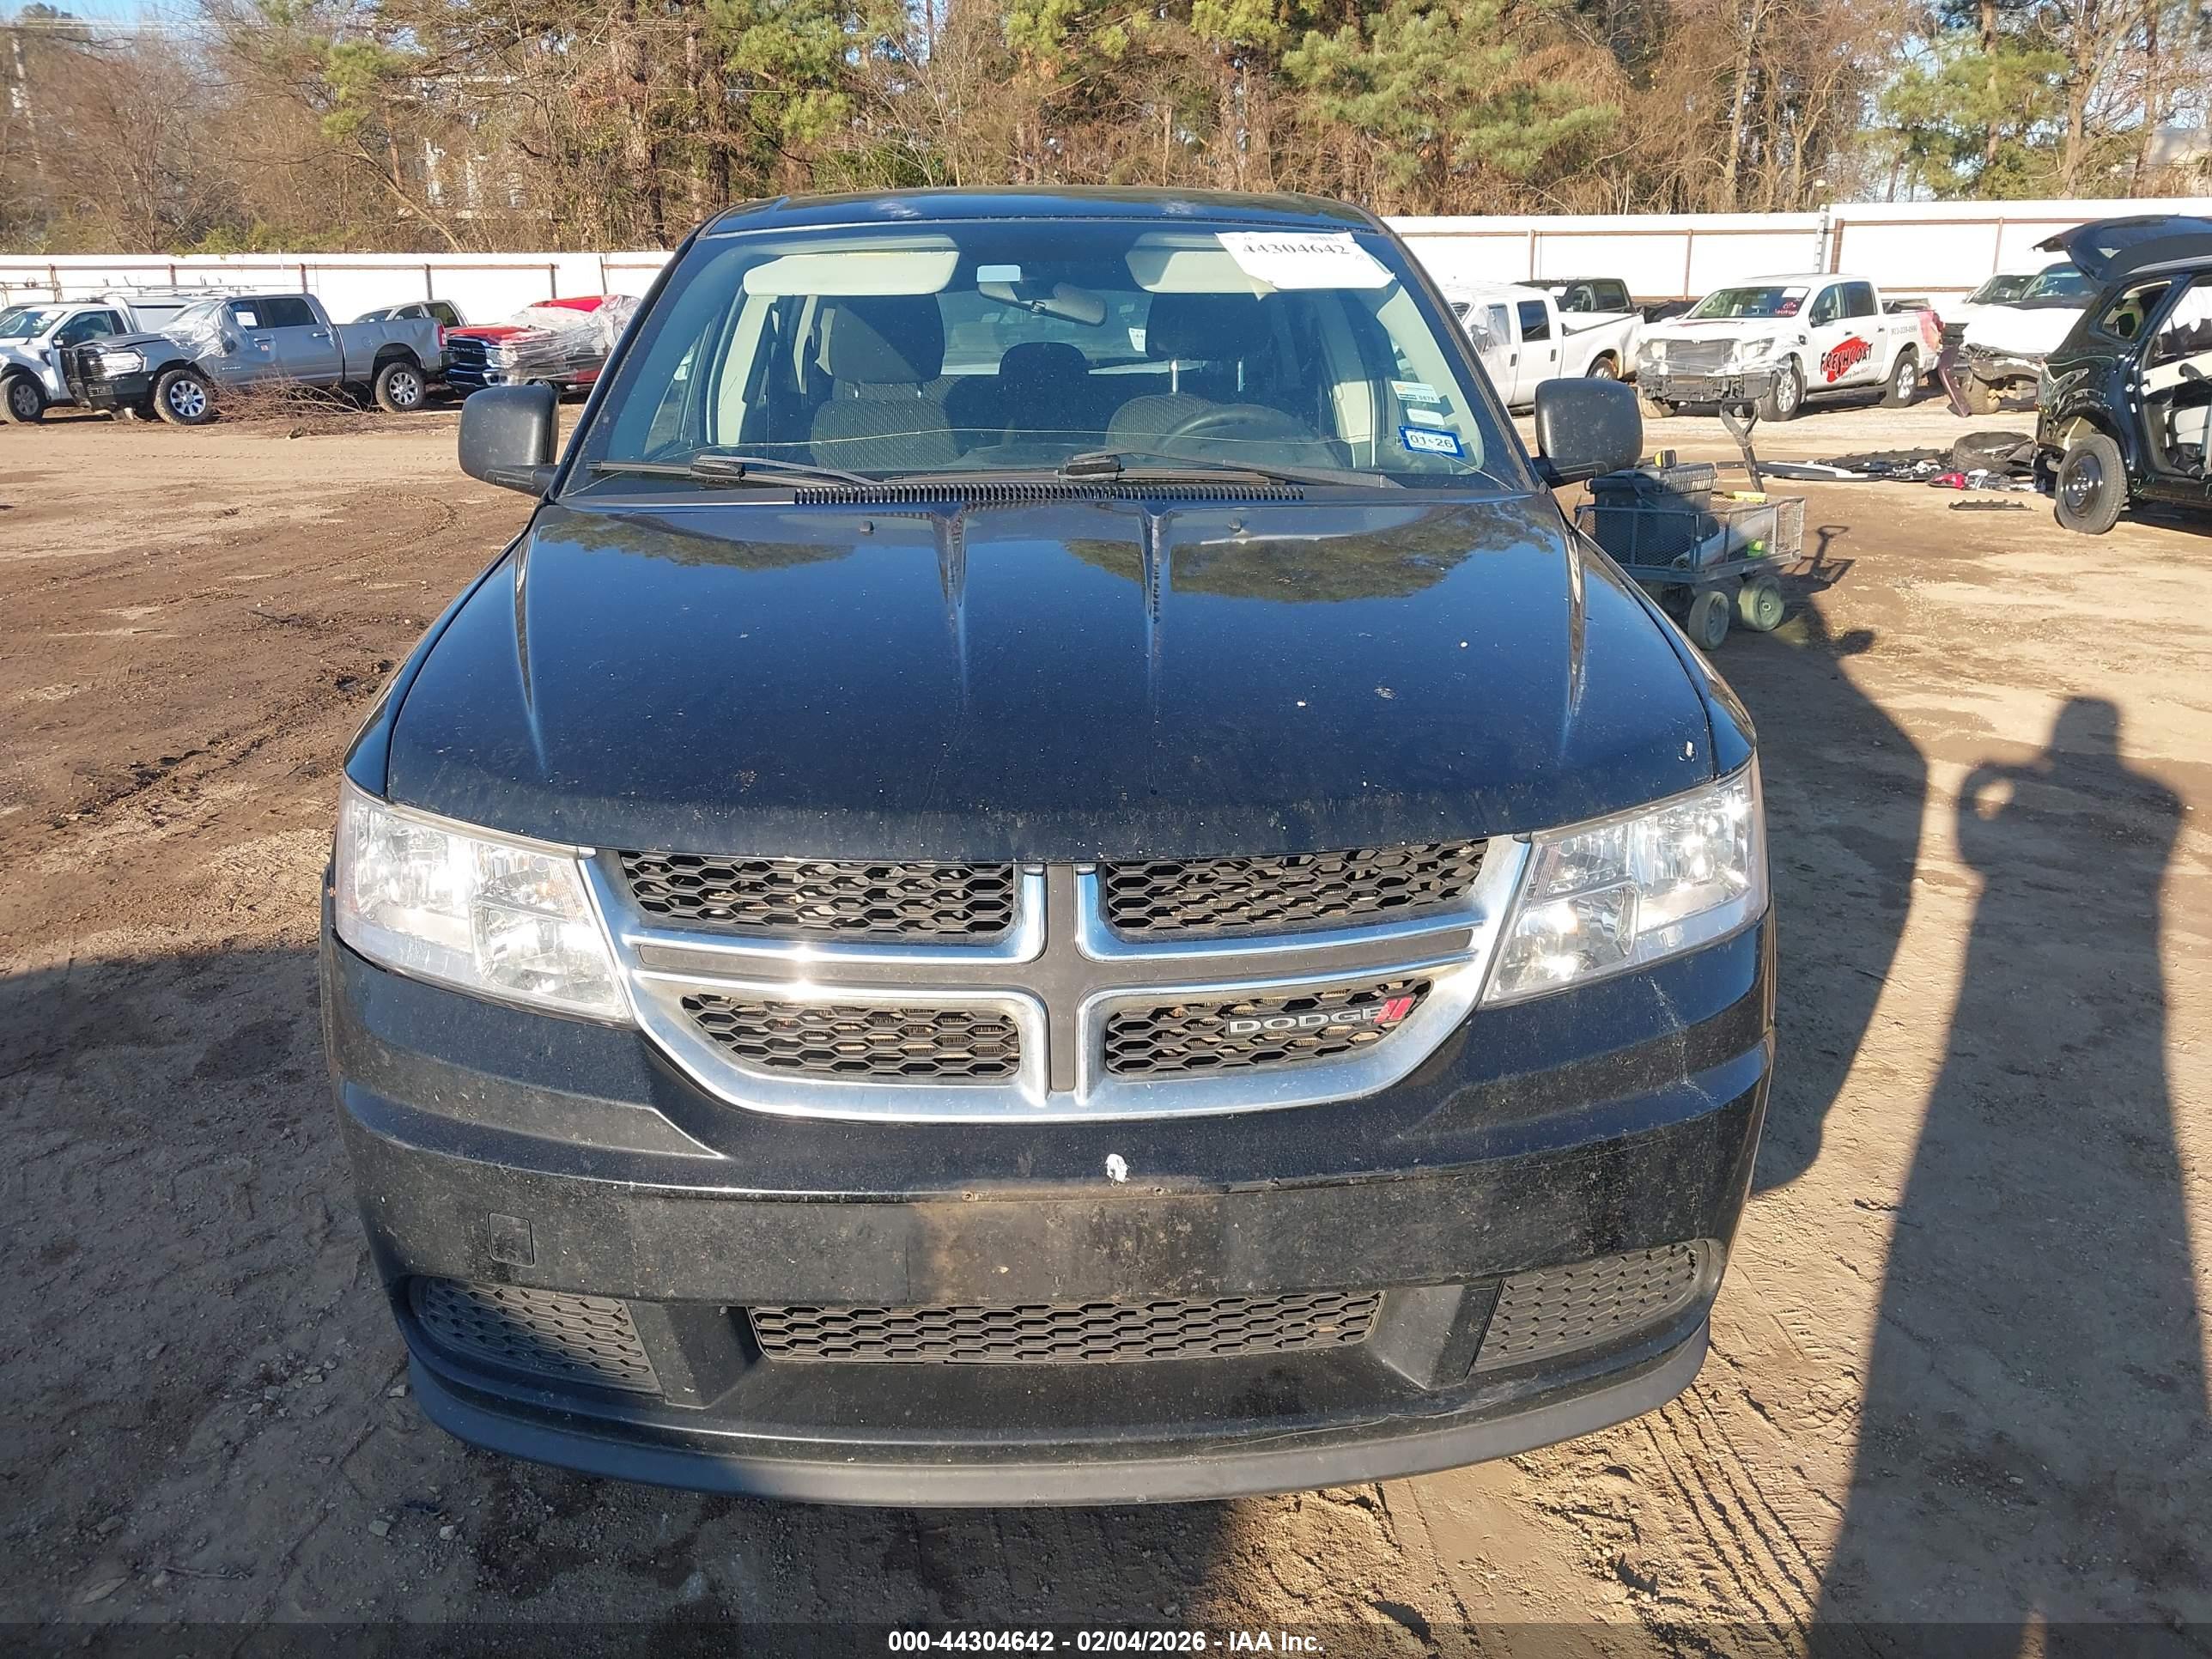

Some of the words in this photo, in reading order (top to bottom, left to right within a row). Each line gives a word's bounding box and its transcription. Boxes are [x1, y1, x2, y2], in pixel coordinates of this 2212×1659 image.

[1243, 243, 1351, 255] 44304642
[1820, 343, 1874, 378] FRESHCOAT
[1230, 1007, 1383, 1033] DODGE
